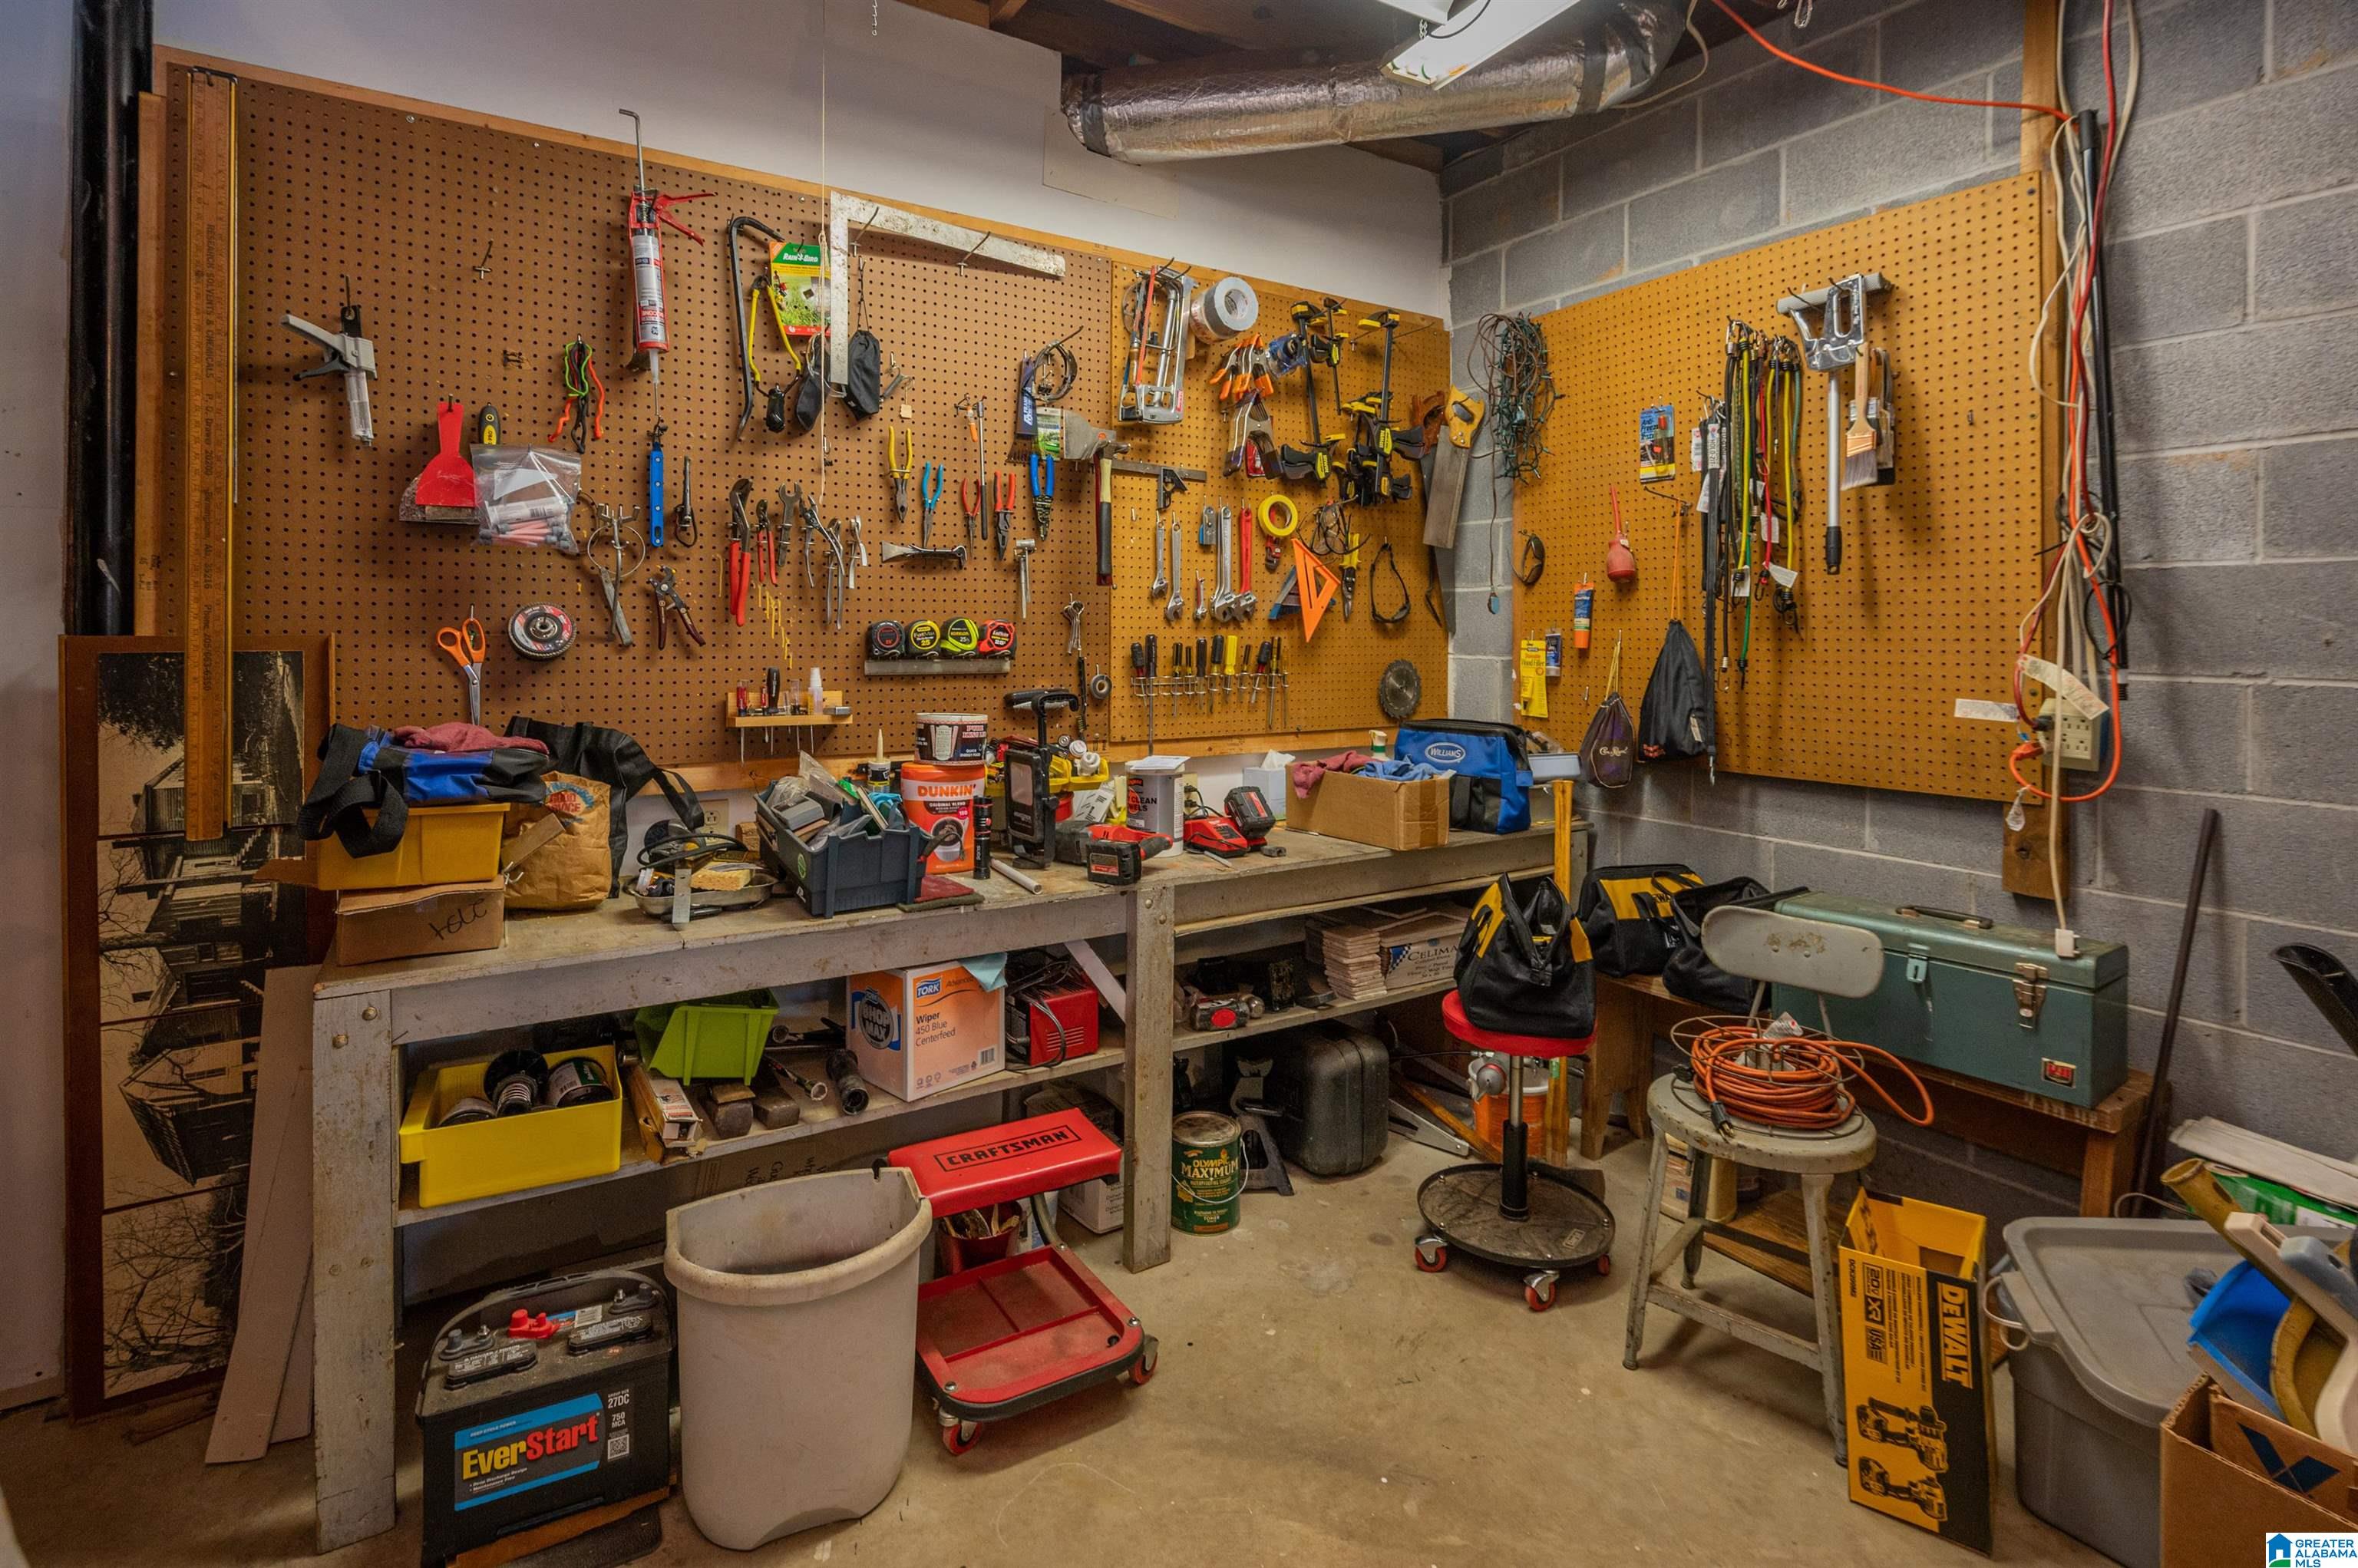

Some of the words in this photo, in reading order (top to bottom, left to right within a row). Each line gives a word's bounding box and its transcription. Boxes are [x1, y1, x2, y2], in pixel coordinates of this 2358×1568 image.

[1430, 747, 1462, 758] WILLIAMS
[917, 983, 940, 997] TORK
[916, 1012, 940, 1025] Wiper
[915, 1025, 930, 1035] 450
[932, 1020, 948, 1030] Blue
[915, 1028, 956, 1047] Centerfeed
[946, 1131, 1069, 1166] CRAFTSMAN
[1868, 1297, 1881, 1321] XR
[608, 1393, 629, 1409] 27DC
[612, 1411, 626, 1420] 750
[612, 1419, 626, 1428] MCA
[463, 1415, 599, 1481] EverStart
